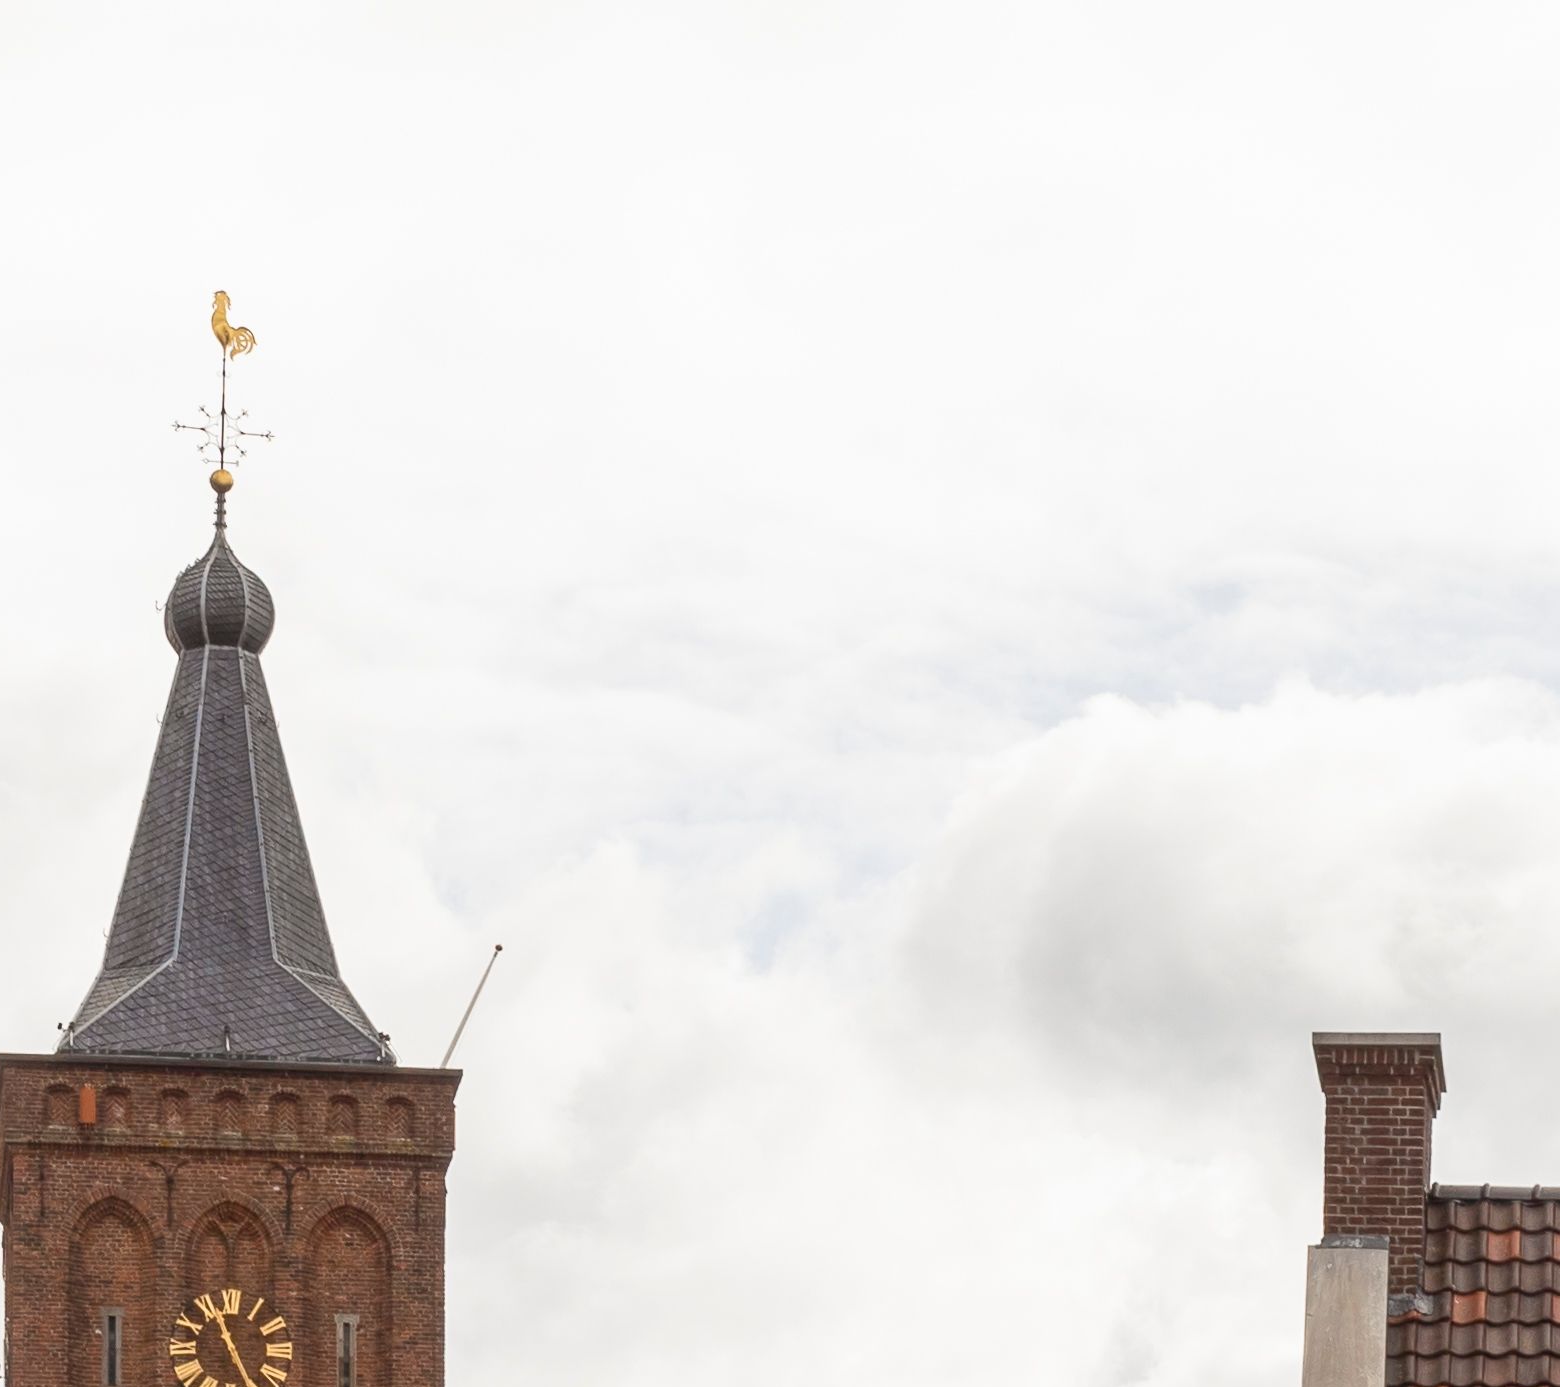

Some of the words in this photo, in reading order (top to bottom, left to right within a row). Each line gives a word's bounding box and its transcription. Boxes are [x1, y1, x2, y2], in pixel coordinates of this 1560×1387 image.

[221, 1288, 241, 1315] XII
[247, 1297, 265, 1322] I
[175, 1312, 204, 1336] X
[259, 1315, 287, 1337] II
[169, 1337, 197, 1356] IX
[265, 1341, 293, 1360] III
